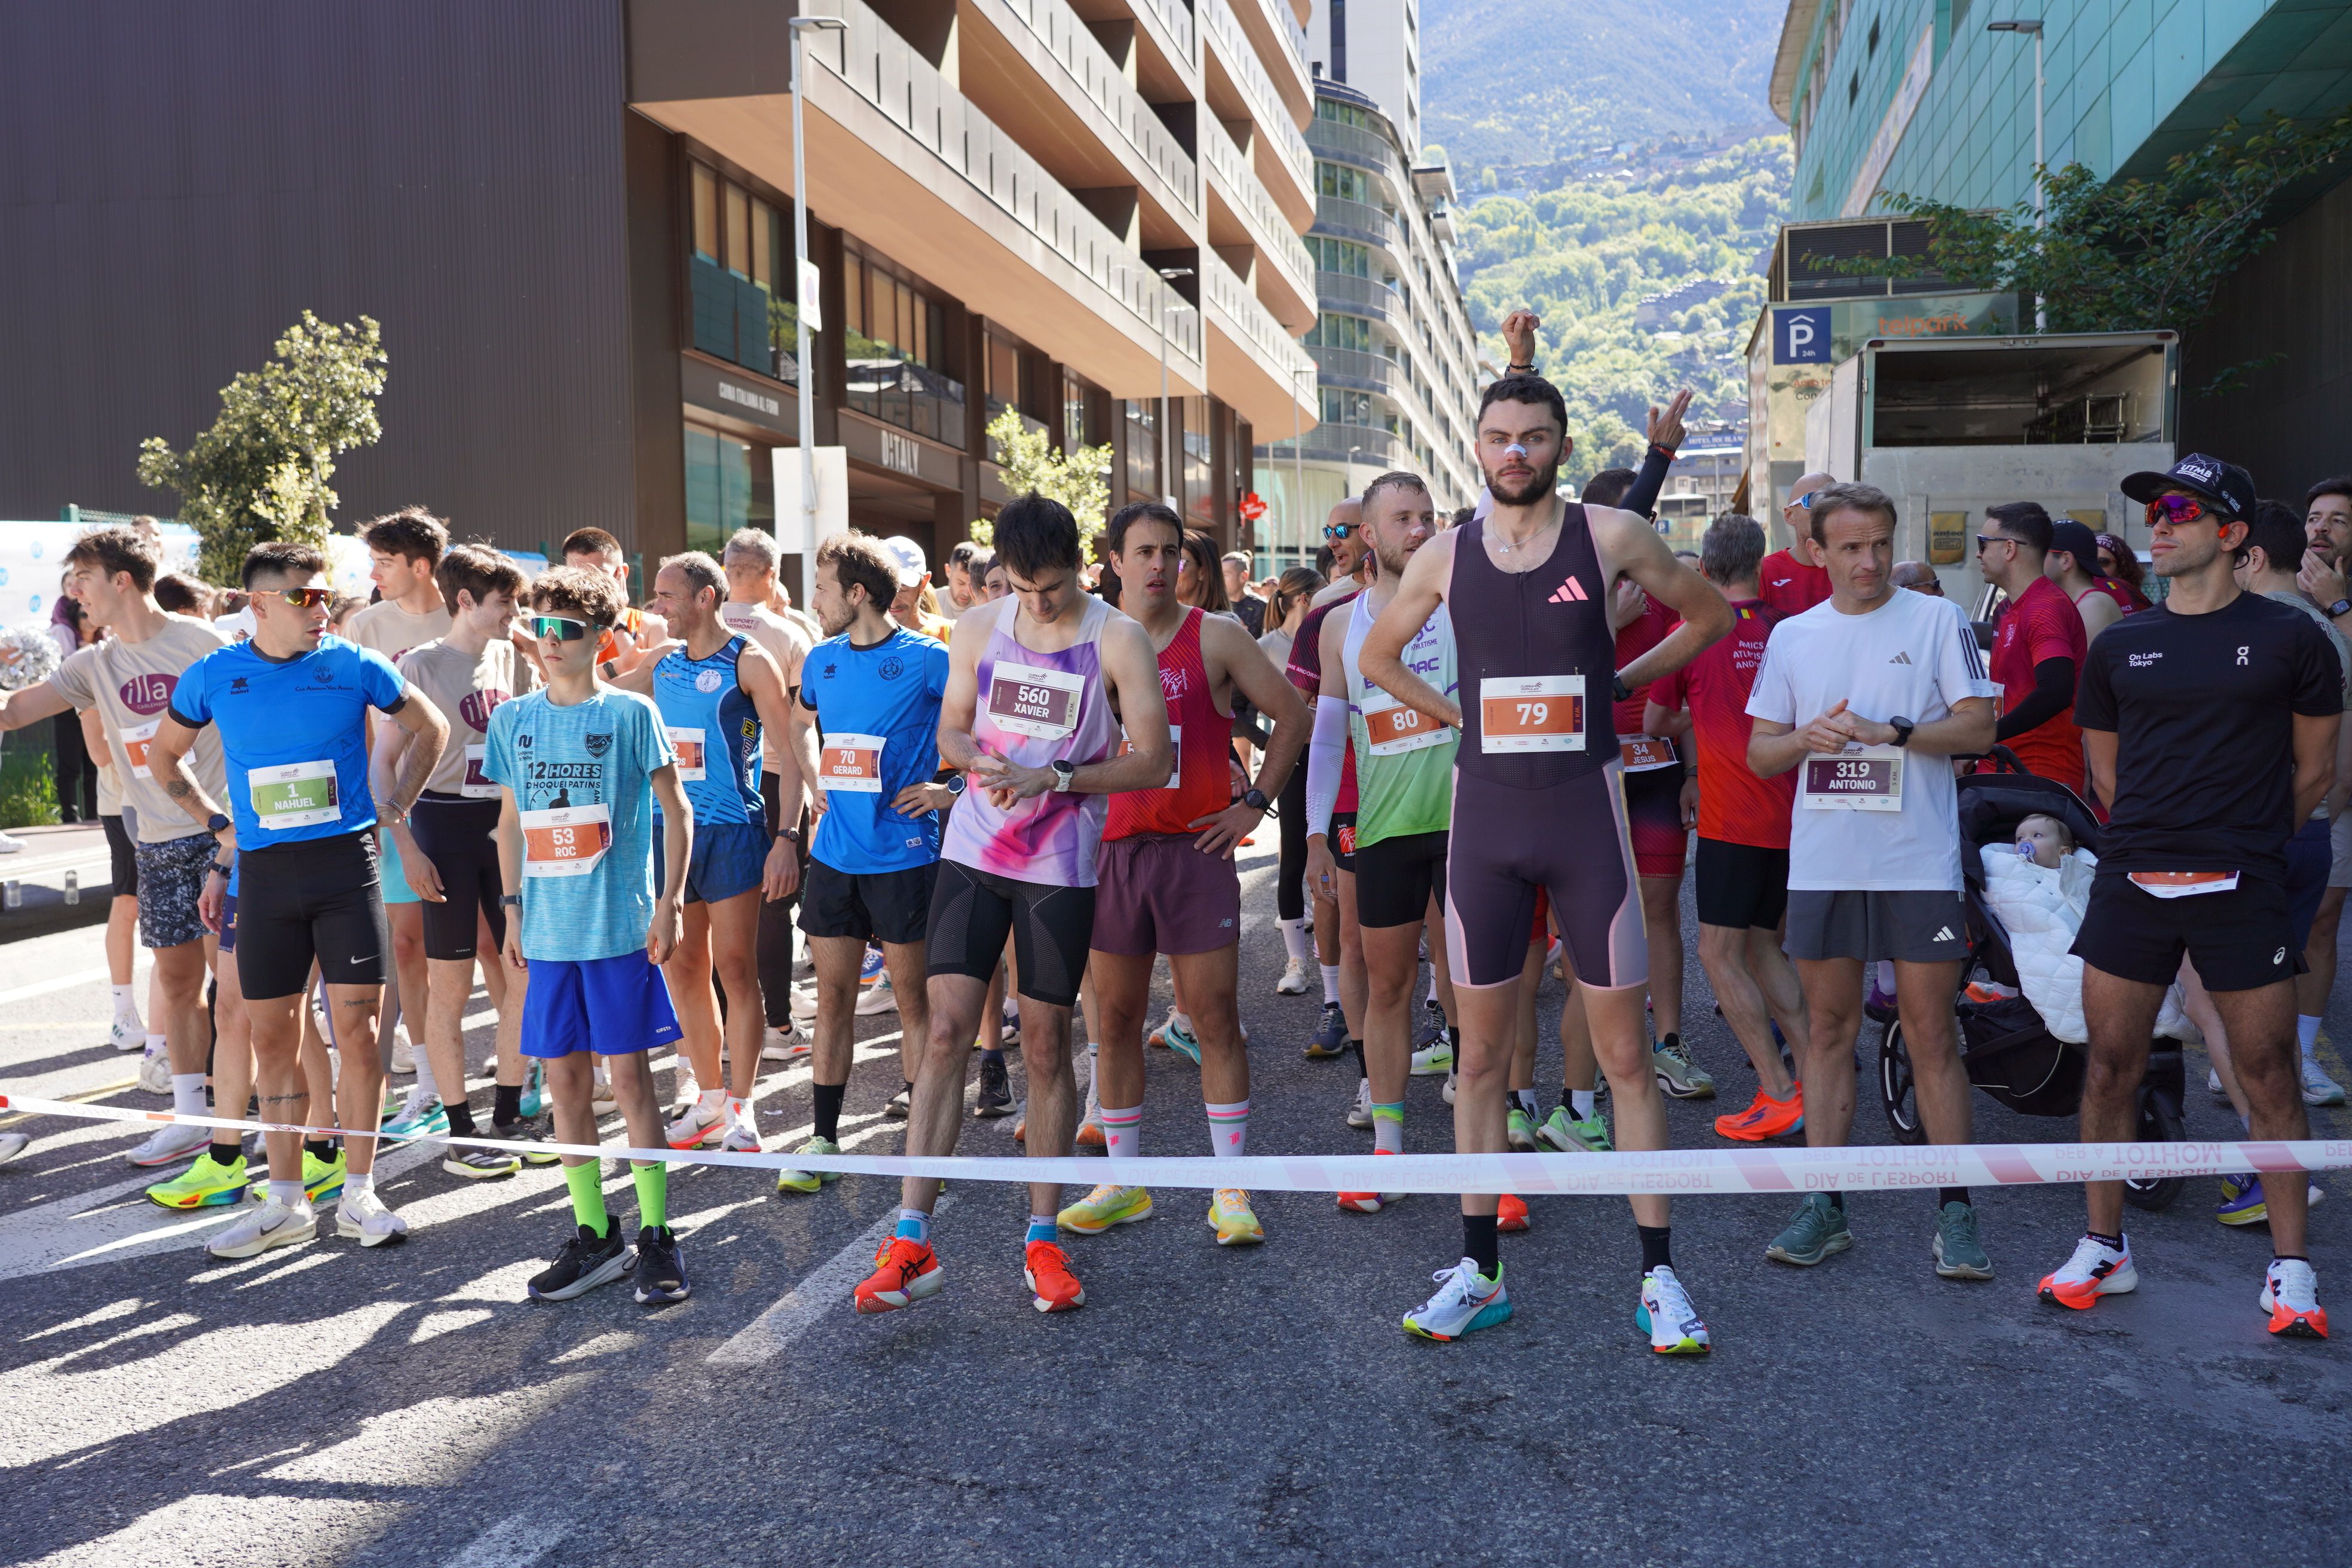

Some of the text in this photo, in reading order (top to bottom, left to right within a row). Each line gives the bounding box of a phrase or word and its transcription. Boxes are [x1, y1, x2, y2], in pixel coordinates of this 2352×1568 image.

[1878, 313, 1969, 338] telpark
[1789, 324, 1814, 358] P
[2180, 464, 2212, 478] UTMB
[1411, 638, 1438, 651] ATHLETISME
[1738, 640, 1763, 649] AMICS
[1296, 667, 1320, 680] ANDORRA
[127, 675, 167, 704] illa
[1018, 685, 1050, 706] 560
[1013, 702, 1050, 718] XAVIER
[1517, 703, 1548, 725] 79
[1392, 709, 1418, 731] 80
[1633, 743, 1649, 755] 34
[841, 750, 855, 765] 70
[1633, 755, 1656, 764] JESUS
[528, 762, 547, 779] 12
[549, 764, 602, 778] HORES
[833, 765, 862, 775] GERARD
[1836, 762, 1870, 778] 319
[287, 783, 299, 798] 1
[526, 781, 567, 789] D'HOQUEI
[1828, 779, 1876, 790] ANTONIO
[274, 797, 316, 811] NAHUEL
[552, 828, 575, 845] 53
[555, 846, 577, 858] ROC
